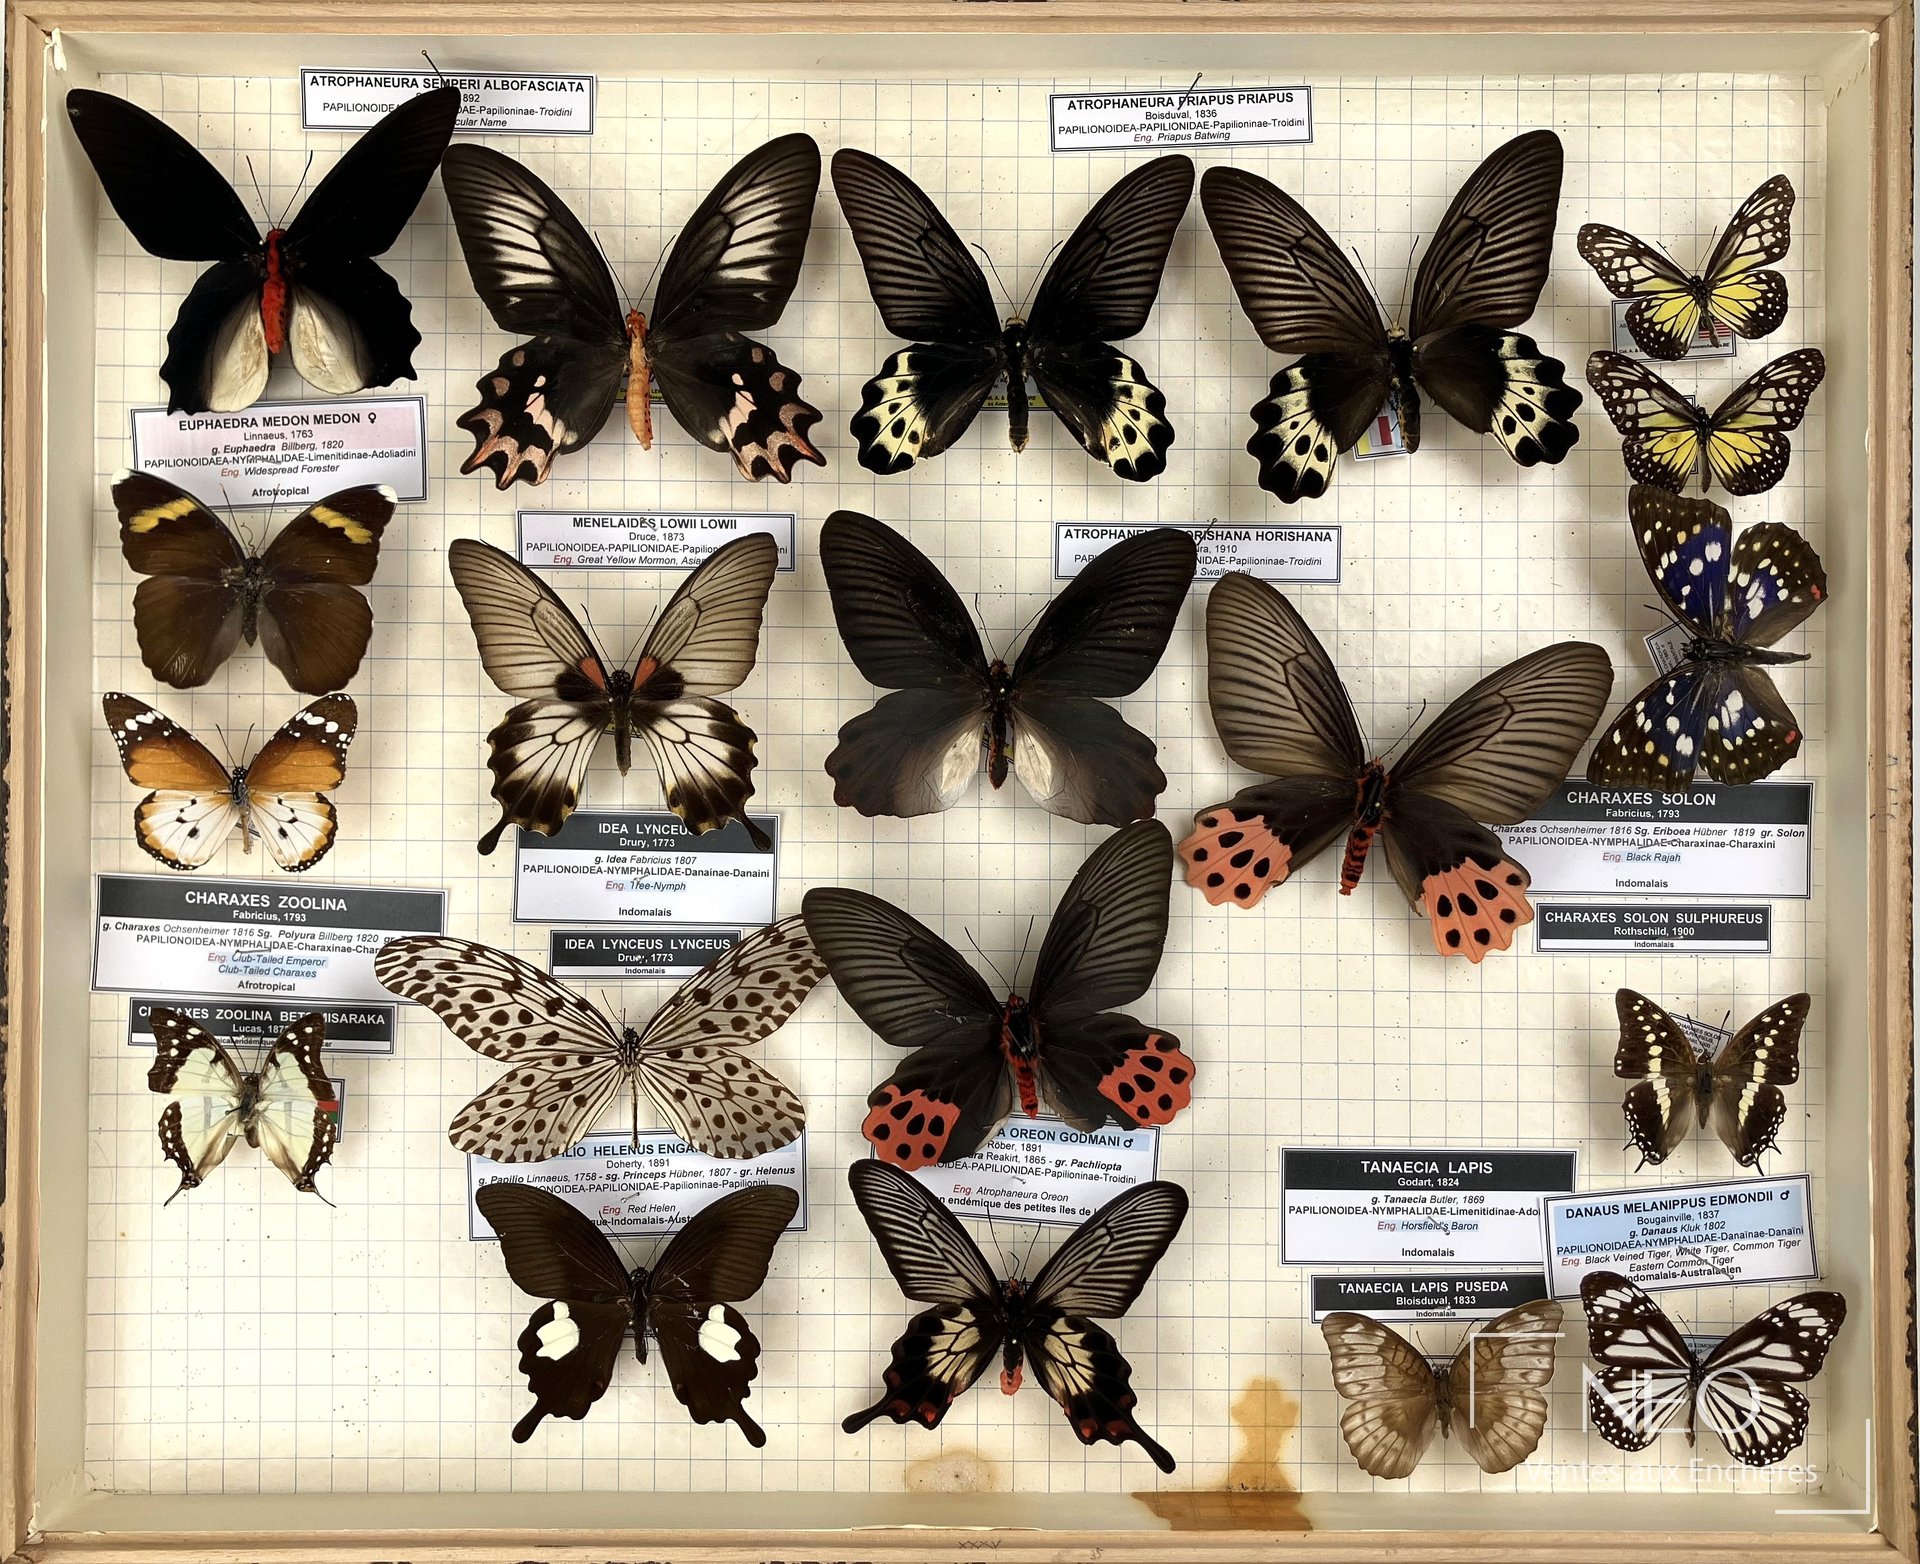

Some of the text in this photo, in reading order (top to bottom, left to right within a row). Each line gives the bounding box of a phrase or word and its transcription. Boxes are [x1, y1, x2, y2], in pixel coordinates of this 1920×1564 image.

[310, 76, 419, 88] ATROPHANEURA
[484, 80, 584, 92] ALBOFASCIATA
[1068, 93, 1293, 110] ATROPHANEURA PRIAPUS PRIAPUS
[1145, 110, 1217, 120] Boisduval, 1836
[1158, 132, 1191, 142] Priapus
[1194, 131, 1230, 141] Batwing
[179, 414, 360, 430] EUPHAEDRA MEDON MEDON
[244, 430, 313, 441] Linnaeus, 1763
[224, 440, 344, 454] Euphaedra Billberg, 1820
[244, 464, 340, 478] Widespread Forester
[252, 486, 309, 497] Afrotropical
[573, 518, 737, 529] MENELAIDES LOWII LOWII
[629, 533, 684, 542] Druce, 1873
[1255, 532, 1332, 542] HORISHANA
[1215, 545, 1237, 553] 1910
[578, 556, 678, 565] Great Yellow Mormon,
[1567, 791, 1716, 806] CHARAXES SOLON
[1606, 809, 1680, 819] Fabricius, 1793
[599, 824, 628, 834] IDEA
[1491, 825, 1805, 837] Charaxes Ochsenheimer 1816 Eriboea Hübner 1819 Solon
[620, 838, 674, 848] Drury, 1773
[606, 855, 627, 863] Idea
[630, 856, 671, 864] Fabricius
[1626, 853, 1681, 863] Black Rajah
[1616, 879, 1668, 888] Indomalais
[185, 891, 347, 911] CHARAXES ZOOLINA
[233, 911, 306, 922] Fabricius, 1793
[619, 908, 671, 916] Indomalais
[1546, 912, 1762, 923] CHARAXES SOLON SULPHUREUS
[115, 921, 378, 943] Charaxes Ochsenheimer 1816 Polyura Billberg 1820
[1614, 926, 1694, 937] Rothschild, 1900
[565, 939, 730, 949] IDEA LYNCEUS LYNCEUS
[232, 953, 326, 967] Club-Tailed Emperor
[218, 964, 316, 978] Club-Tailed Charaxes
[238, 980, 295, 991] Afrotropical
[216, 1009, 272, 1021] ZOOLINA
[1010, 1128, 1055, 1141] OREON
[1059, 1133, 1120, 1146] GODMANI
[594, 1144, 654, 1157] HELENUS
[988, 1141, 1041, 1152] Röber, 1891
[607, 1159, 670, 1169] Doherty, 1891
[987, 1152, 1020, 1163] Reakirt,
[1024, 1155, 1046, 1164] 1865
[1071, 1159, 1122, 1171] Pachliopta
[1361, 1161, 1492, 1174] TANAECIA LAPIS
[491, 1166, 795, 1184] Papilio Linnaeus, 1758 Princeps Hübner, 1807 Helenus
[1398, 1178, 1459, 1188] Godart, 1824
[976, 1186, 1068, 1201] Atrophaneura Oreon
[1384, 1194, 1484, 1204] Tanaecia Butler, 1869
[628, 1203, 675, 1213] Red Helen
[948, 1197, 1001, 1208] endémique
[1004, 1201, 1021, 1210] des
[1024, 1203, 1056, 1213] petites
[1566, 1191, 1772, 1218] DANAUS MELANIPPUS EDMONDII
[1637, 1210, 1719, 1226] Bougainville, 1837
[1451, 1222, 1478, 1230] Baron
[1641, 1221, 1725, 1236] Danaus Kluk 1802
[1402, 1248, 1454, 1256] Indomalais
[1585, 1239, 1801, 1264] Black Veined Tiger, White Tiger, Common Tiger
[1629, 1255, 1734, 1272] Eastern Common Tiger
[1339, 1282, 1508, 1294] TANAECIA LAPIS PUSEDA
[1396, 1296, 1476, 1306] Bloisduval, 1833
